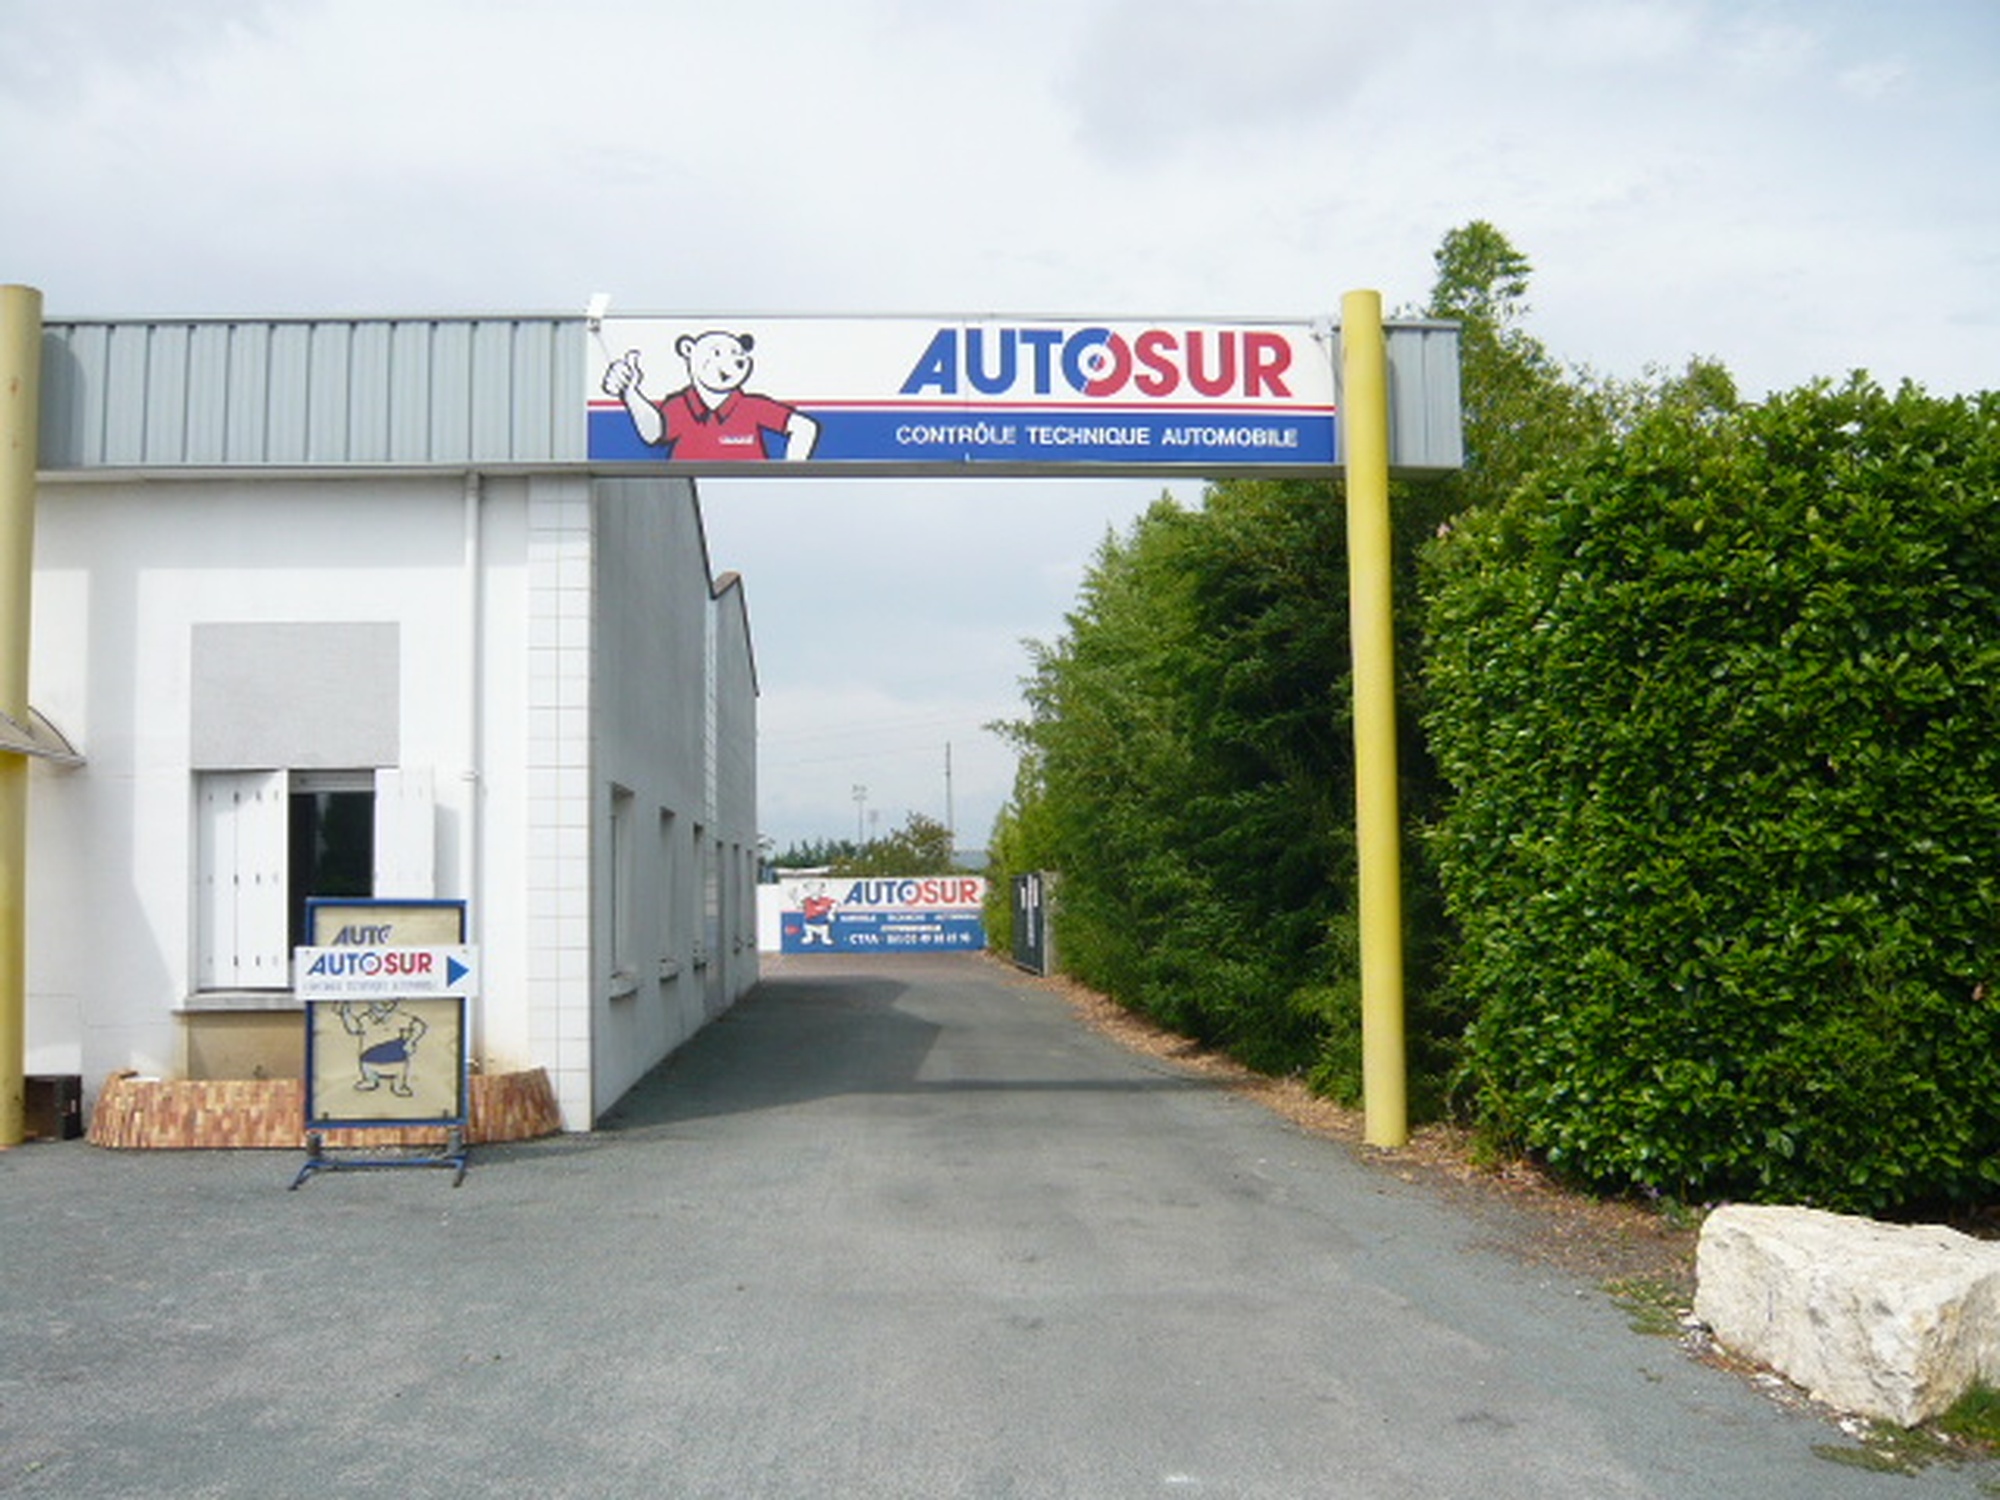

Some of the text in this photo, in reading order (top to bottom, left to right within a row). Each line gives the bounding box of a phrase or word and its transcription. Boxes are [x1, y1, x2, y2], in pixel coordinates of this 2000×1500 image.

[898, 327, 1293, 397] AUTOSUR
[896, 420, 1298, 447] CONTRÔLE TECHNIQUE AUTOMOBILE
[846, 880, 977, 904] AUTOSUR
[308, 952, 432, 976] AUTOSUR
